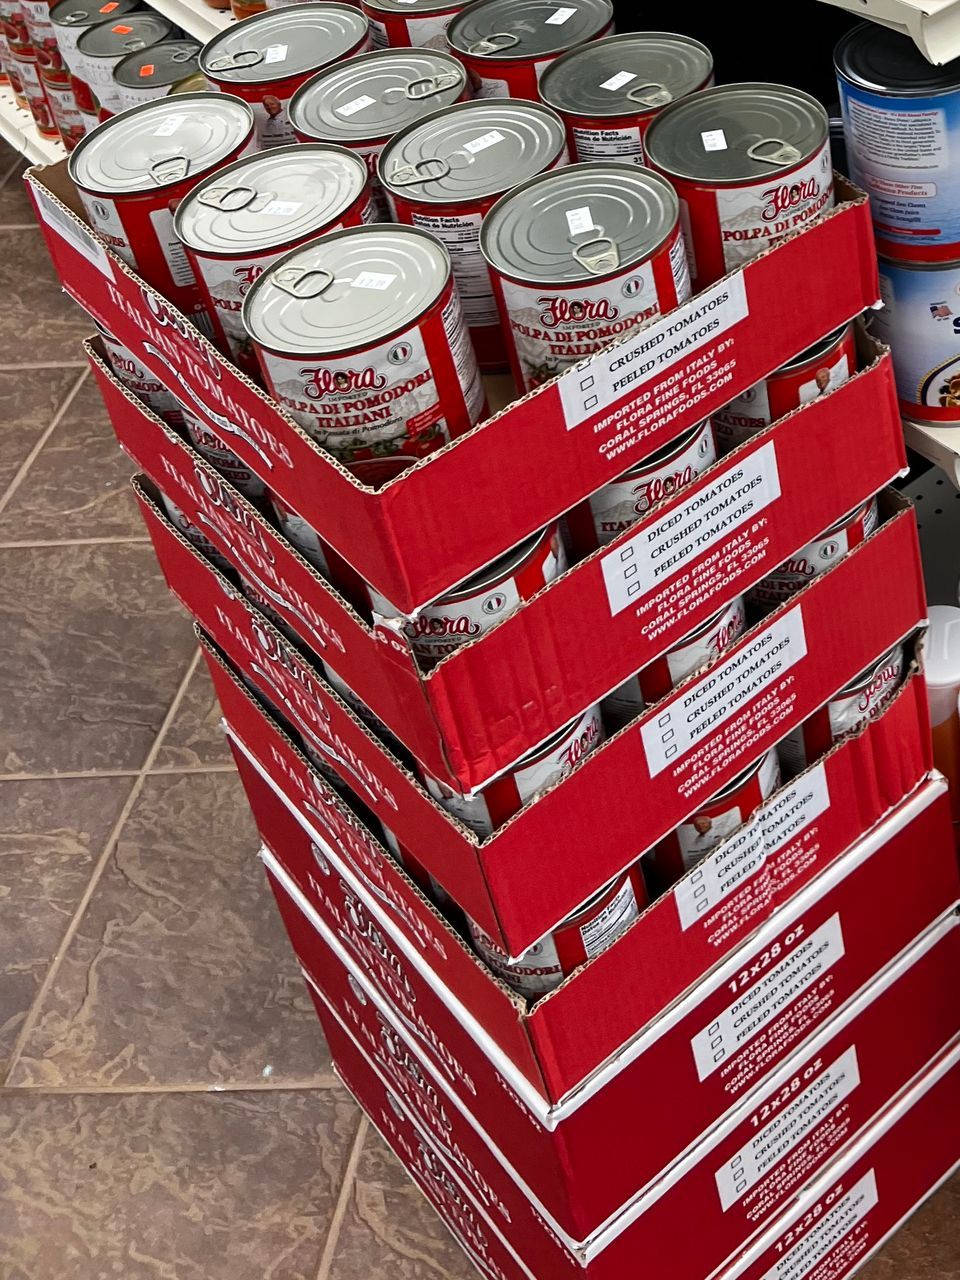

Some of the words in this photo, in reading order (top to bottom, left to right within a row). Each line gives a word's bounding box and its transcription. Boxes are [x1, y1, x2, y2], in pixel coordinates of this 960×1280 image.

[722, 225, 772, 242] POLPA
[775, 220, 790, 233] DI
[761, 176, 820, 223] Flora
[511, 319, 555, 342] POLPA
[555, 330, 572, 342] DI
[575, 303, 660, 342] POMODORI
[537, 294, 620, 330] Flora
[608, 332, 666, 373] CRUSHED
[666, 292, 730, 338] TOMATOES
[300, 367, 387, 402] Flora
[321, 403, 342, 416] DI
[343, 368, 433, 414] POMODORI
[593, 391, 652, 433] IMPORTED
[653, 369, 685, 396] FROM
[685, 349, 717, 374] ITALY
[717, 338, 736, 355] BY:
[612, 359, 656, 393] PEELED
[656, 318, 721, 364] TOMATOES
[316, 406, 394, 429] ITALIANI
[598, 425, 637, 454] CORAL
[638, 391, 691, 428] SPRINGS,
[691, 381, 704, 395] FL
[705, 359, 738, 384] 33065
[606, 373, 734, 461] WWW.FLORAFOODS.COM
[615, 403, 653, 431] FLORA
[654, 386, 681, 407] FINE
[682, 360, 719, 388] FOODS
[647, 512, 683, 543] DICED
[683, 469, 745, 517] TOMATOES
[650, 518, 703, 560] CRUSHED
[703, 475, 763, 523] TOMATOES
[653, 543, 694, 578] PEELED
[694, 500, 755, 548] TOMATOES
[635, 573, 691, 617] IMPORTED
[690, 550, 722, 577] FROM
[721, 531, 751, 556] ITALY
[640, 607, 677, 636] CORAL
[677, 573, 727, 610] SPRINGS,
[726, 560, 740, 575] FL
[740, 536, 771, 562] 33065
[647, 549, 768, 641] WWW.FLORAFOODS.COM
[656, 585, 693, 614] FLORA
[693, 566, 719, 587] FINE
[718, 540, 753, 569] FOODS
[683, 679, 718, 709] DICED
[716, 632, 774, 683] TOMATOES
[686, 682, 736, 724] CRUSHED
[735, 636, 791, 685] TOMATOES
[689, 707, 727, 740] PEELED
[727, 661, 784, 708] TOMATOES
[727, 941, 783, 994] 12x28
[750, 1076, 802, 1127] 12x28
